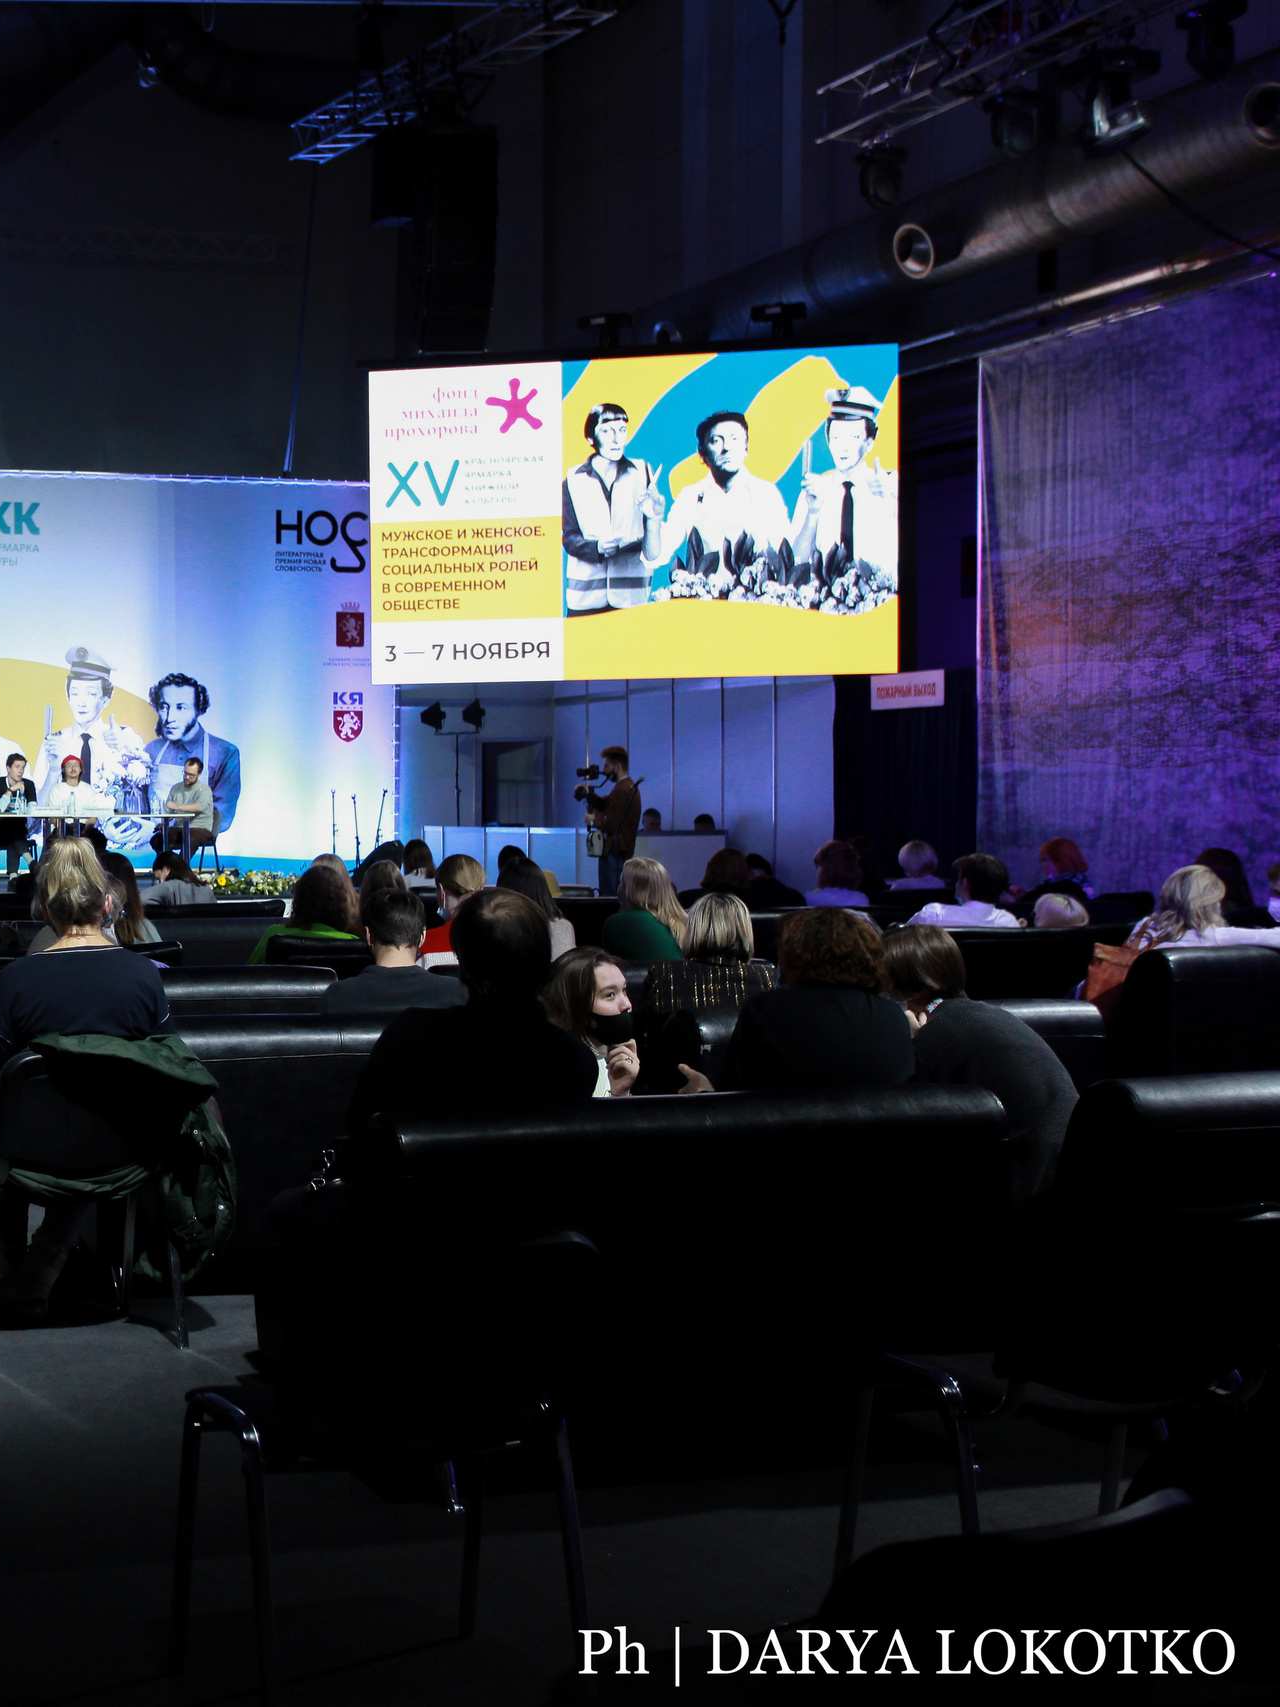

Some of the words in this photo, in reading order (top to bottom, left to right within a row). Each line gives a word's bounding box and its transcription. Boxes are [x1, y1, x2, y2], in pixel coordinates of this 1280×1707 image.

[385, 425, 478, 441] прохорова
[385, 459, 460, 508] XV
[381, 529, 453, 542] МУЖСКОЕ
[457, 529, 467, 539] И
[471, 526, 546, 539] ЖЕНСКОЕ.
[382, 544, 513, 559] ТРАНСФОРМАЦИЯ
[382, 562, 485, 577] СОЦИАЛЬНЫХ
[489, 557, 538, 572] РОЛЕЙ
[382, 583, 391, 593] В
[395, 579, 506, 593] СОВРЕМЕННОМ
[382, 598, 461, 612] ОБЩЕСТВЕ
[385, 645, 397, 662] 3
[432, 644, 444, 661] 7
[452, 641, 550, 660] НОЯБРЯ
[333, 692, 363, 705] КЯ
[876, 682, 912, 699] ПОЖАРНЫЙ
[913, 682, 936, 698] ВЫХОД
